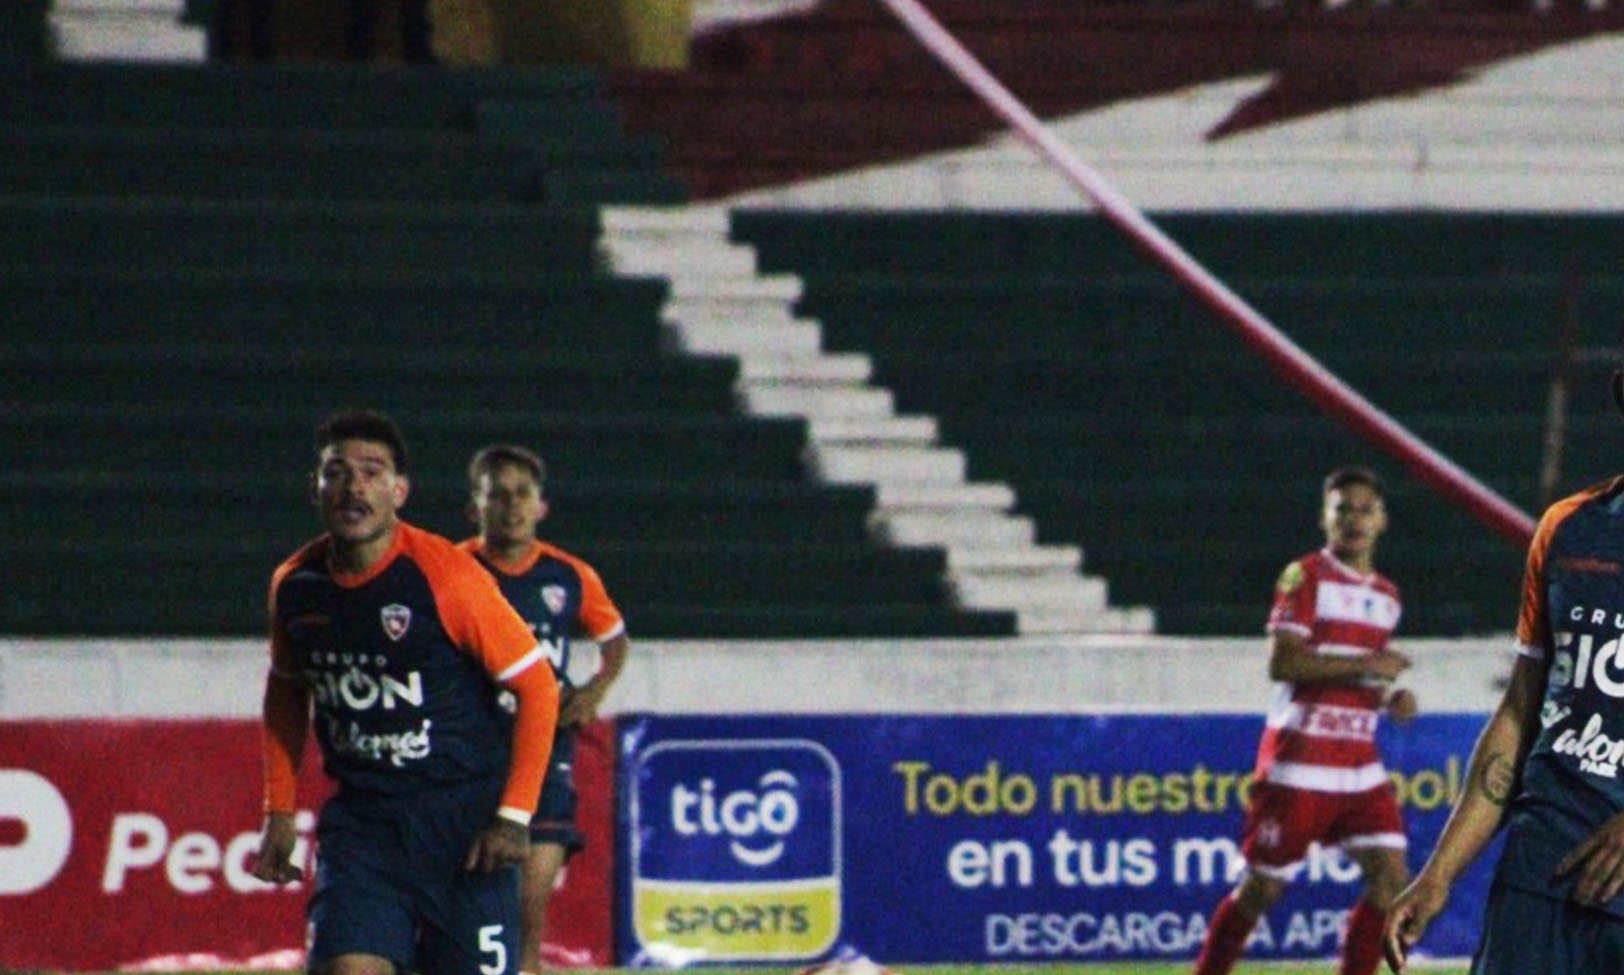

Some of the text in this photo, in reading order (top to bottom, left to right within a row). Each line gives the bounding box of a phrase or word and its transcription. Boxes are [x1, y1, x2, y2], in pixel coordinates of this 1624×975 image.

[311, 651, 387, 666] GRUPO
[893, 761, 1036, 815] Todo
[947, 840, 1032, 887] en
[1050, 830, 1157, 886] tus
[665, 905, 810, 935] SPORTS
[985, 913, 1209, 955] DESCARGA
